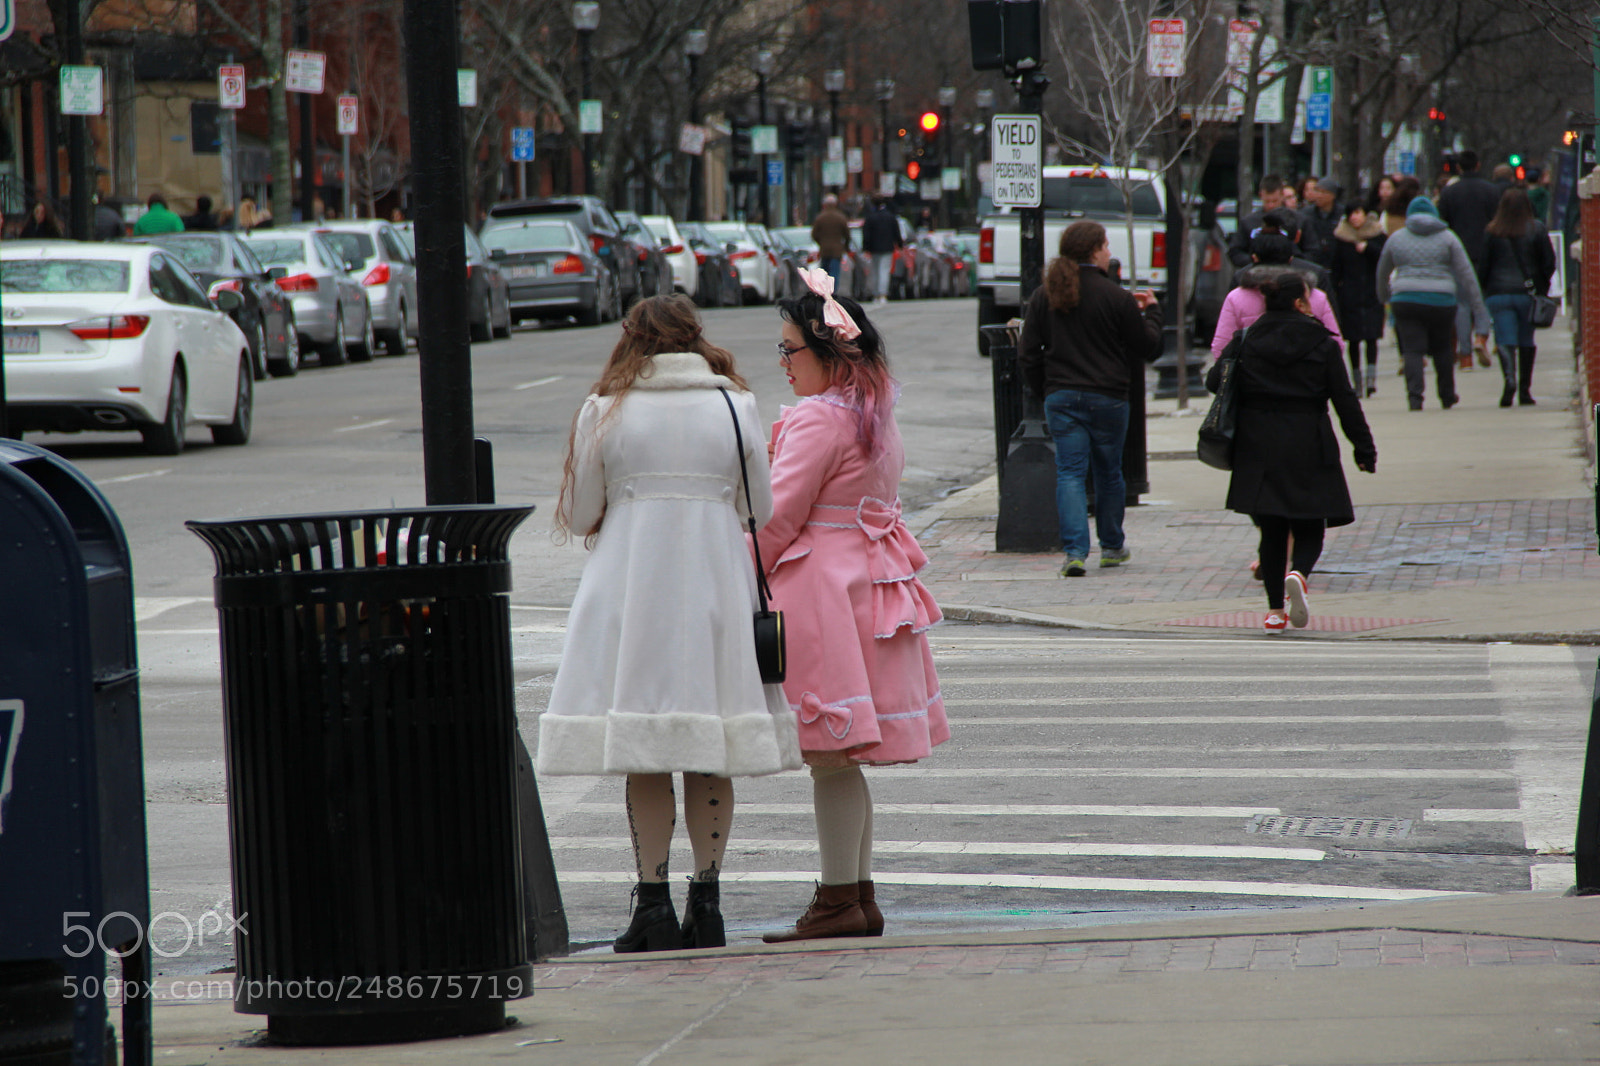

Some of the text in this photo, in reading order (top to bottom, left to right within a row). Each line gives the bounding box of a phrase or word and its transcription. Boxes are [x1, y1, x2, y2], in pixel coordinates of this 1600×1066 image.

[997, 124, 1036, 146] YIELD
[1012, 149, 1021, 160] TO
[996, 163, 1036, 179] PEDESTRIANS
[998, 182, 1035, 199] ON TURNS
